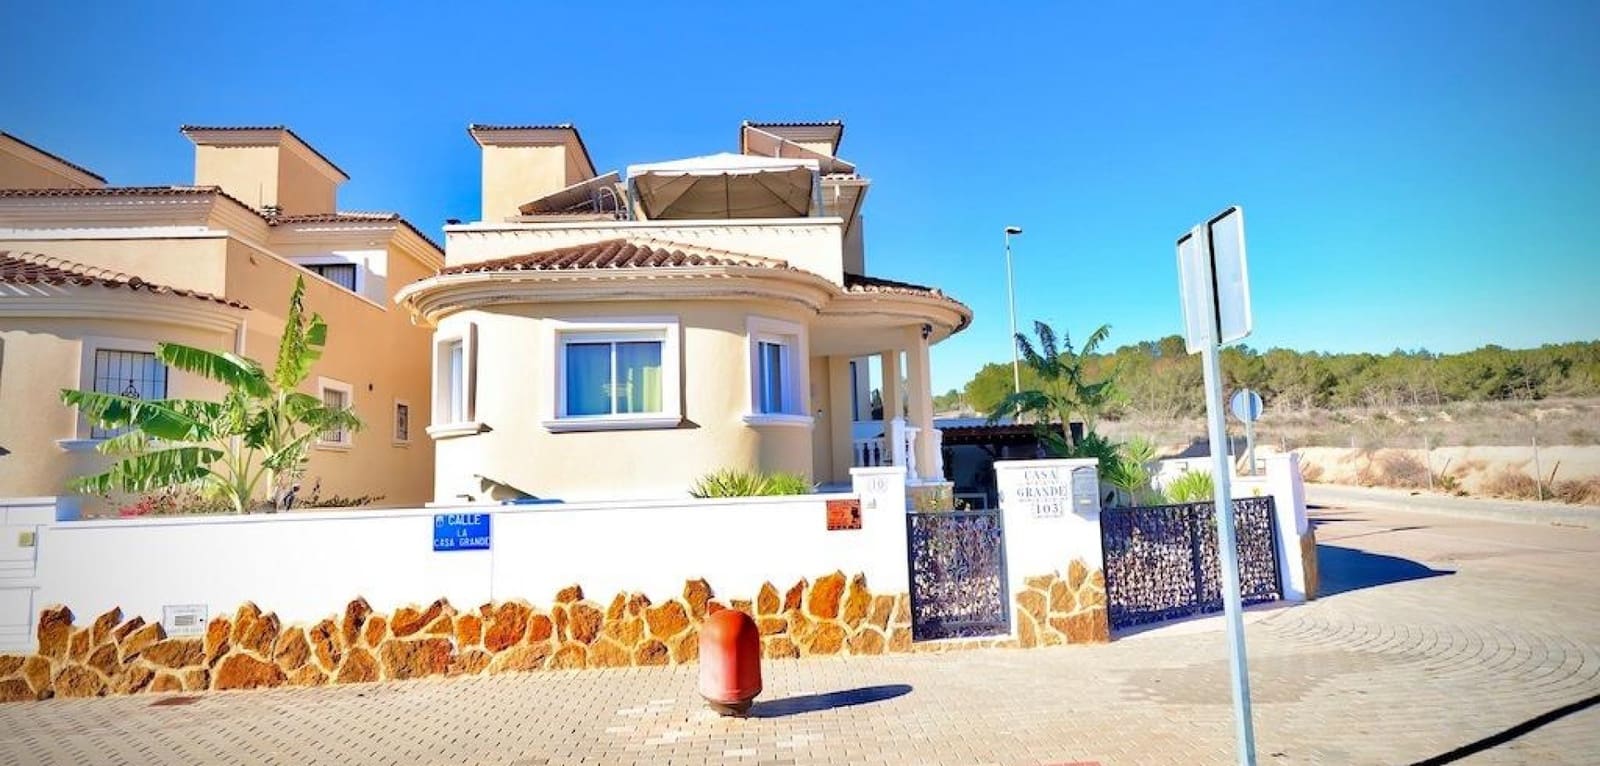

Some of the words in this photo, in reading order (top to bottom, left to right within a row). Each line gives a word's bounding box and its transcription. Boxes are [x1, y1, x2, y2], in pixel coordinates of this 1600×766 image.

[1024, 470, 1056, 480] CASA
[1016, 486, 1067, 497] GRANDE
[1036, 503, 1059, 514] 103
[447, 514, 481, 525] CALLE
[457, 529, 468, 537] LA
[434, 538, 455, 547] CASA
